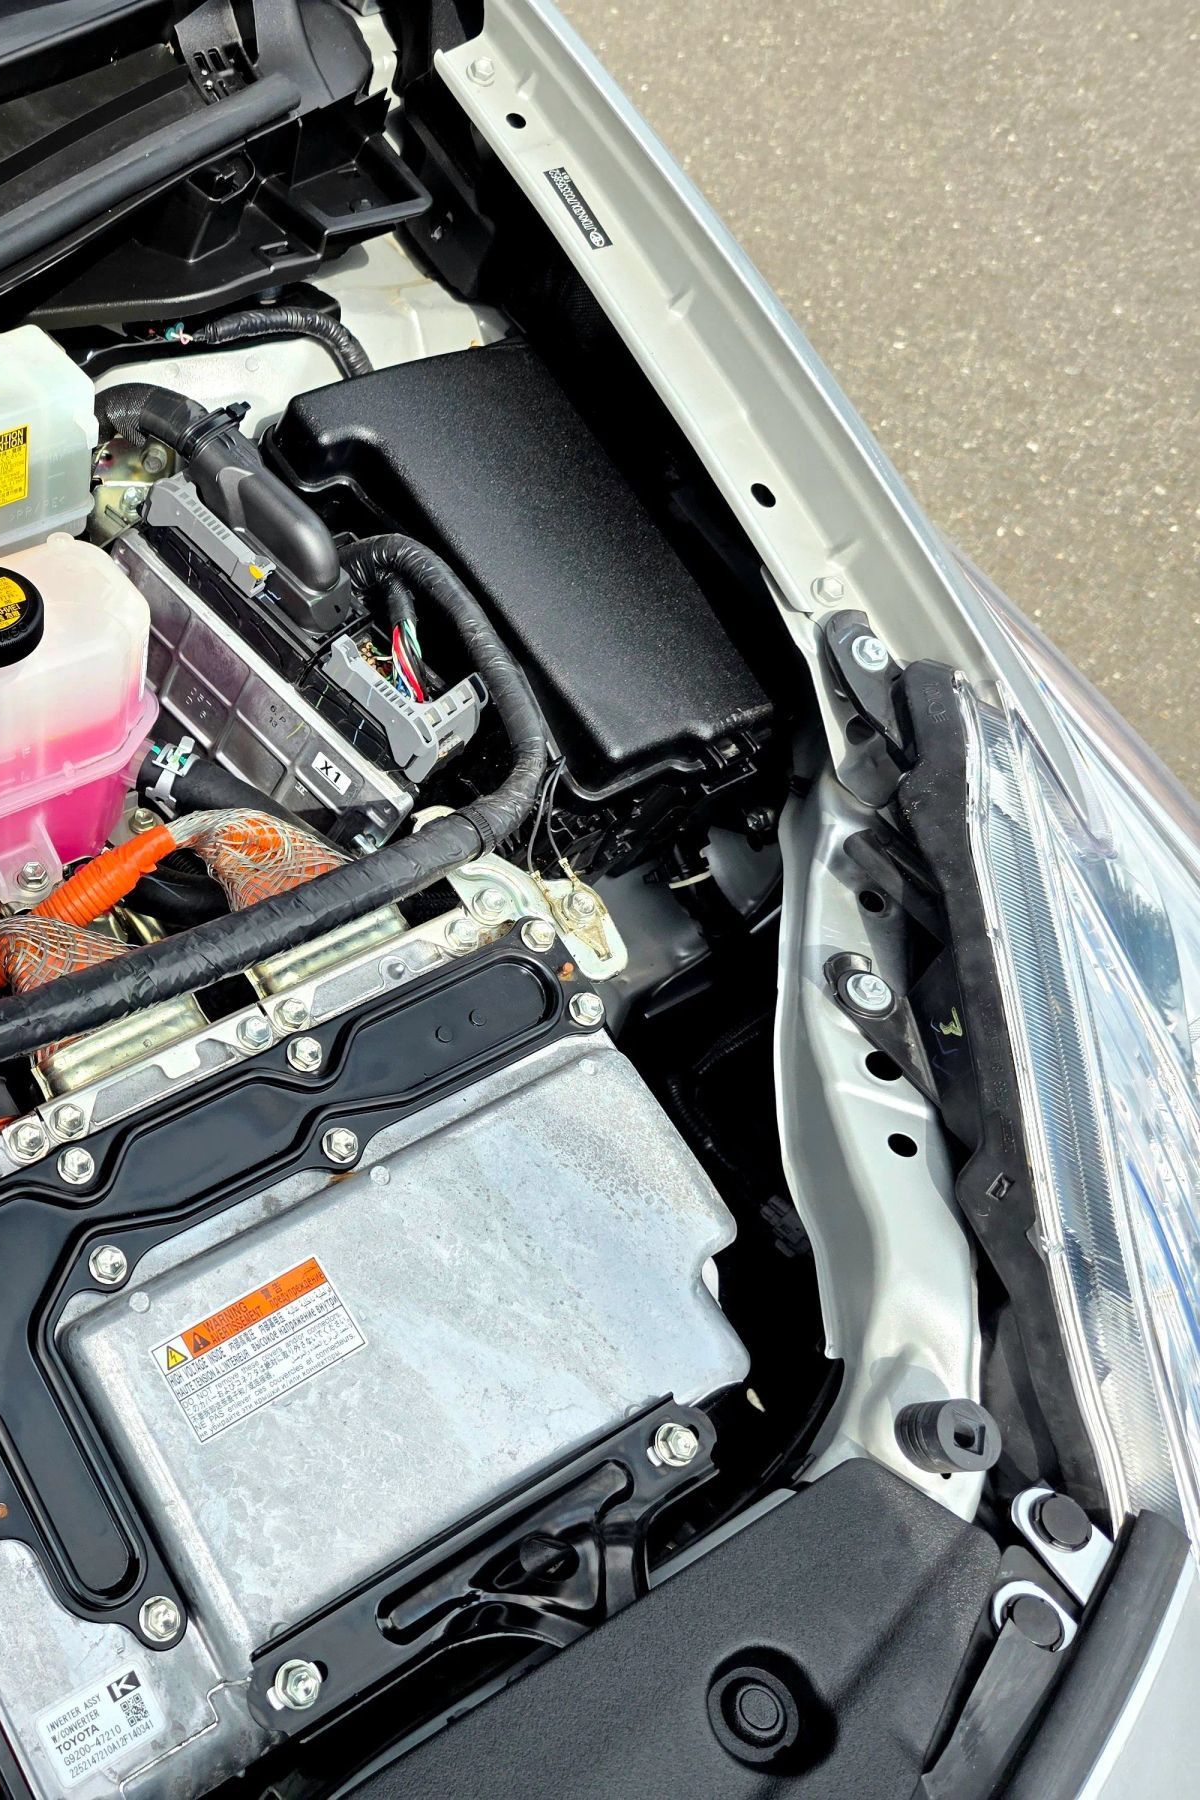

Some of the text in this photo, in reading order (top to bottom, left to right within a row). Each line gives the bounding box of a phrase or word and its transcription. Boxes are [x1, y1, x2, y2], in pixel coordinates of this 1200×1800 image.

[269, 1270, 324, 1310] предупреждение
[203, 1300, 247, 1332] WARNING
[210, 1304, 264, 1344] AVERTISSEMENT
[168, 1345, 225, 1388] HIGH VOLTAGE INSIDE
[175, 1380, 194, 1398] HAUTE
[192, 1367, 215, 1388] TENSION
[182, 1397, 194, 1409] DO
[196, 1386, 213, 1401] NOT
[214, 1371, 239, 1389] remove
[241, 1358, 259, 1374] these
[261, 1345, 283, 1362] covers
[284, 1331, 305, 1348] and/or
[194, 1420, 207, 1432] NE
[208, 1409, 225, 1423] PAS
[226, 1393, 251, 1413] enlever
[253, 1385, 267, 1396] ces
[268, 1362, 303, 1388] couvercles
[305, 1357, 313, 1365] et
[198, 1429, 208, 1439] не
[240, 1402, 253, 1413] эти
[46, 1693, 101, 1732] INVERTER ASSY
[51, 1708, 99, 1744] W/CONVERTER
[56, 1723, 99, 1755] TOYOTA
[63, 1723, 122, 1766] G9200-47210
